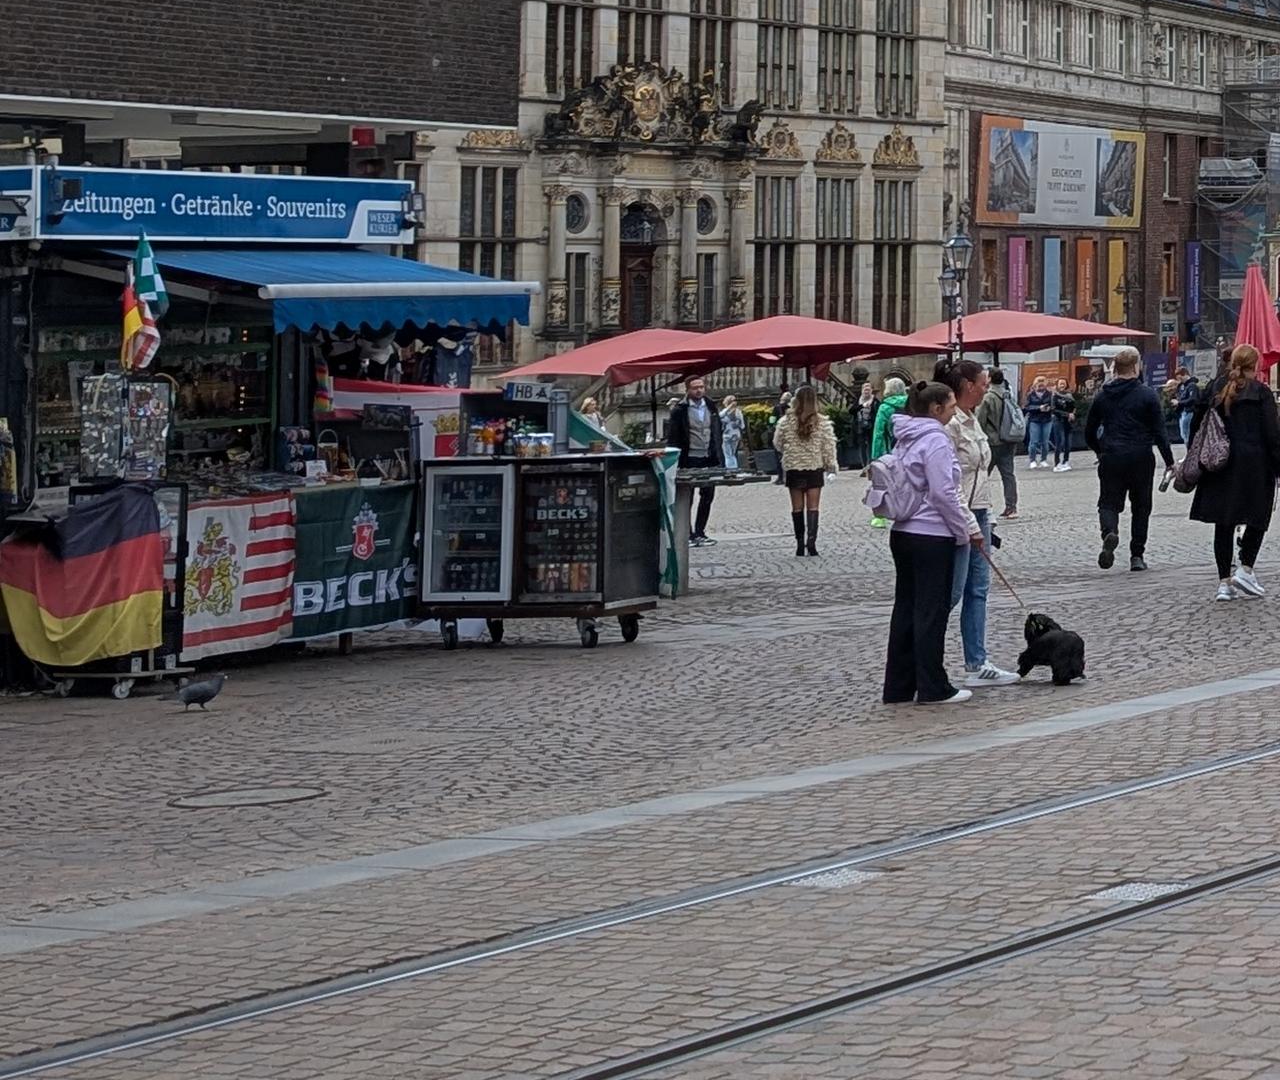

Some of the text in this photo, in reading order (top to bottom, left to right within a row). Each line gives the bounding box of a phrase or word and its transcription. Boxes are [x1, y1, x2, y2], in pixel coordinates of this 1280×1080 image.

[62, 191, 346, 221] Zeitungen Getränke Souvenirs
[369, 212, 396, 224] WESER
[369, 223, 398, 235] KURIER
[536, 507, 588, 520] BECK'S
[292, 558, 417, 617] BECK'S
